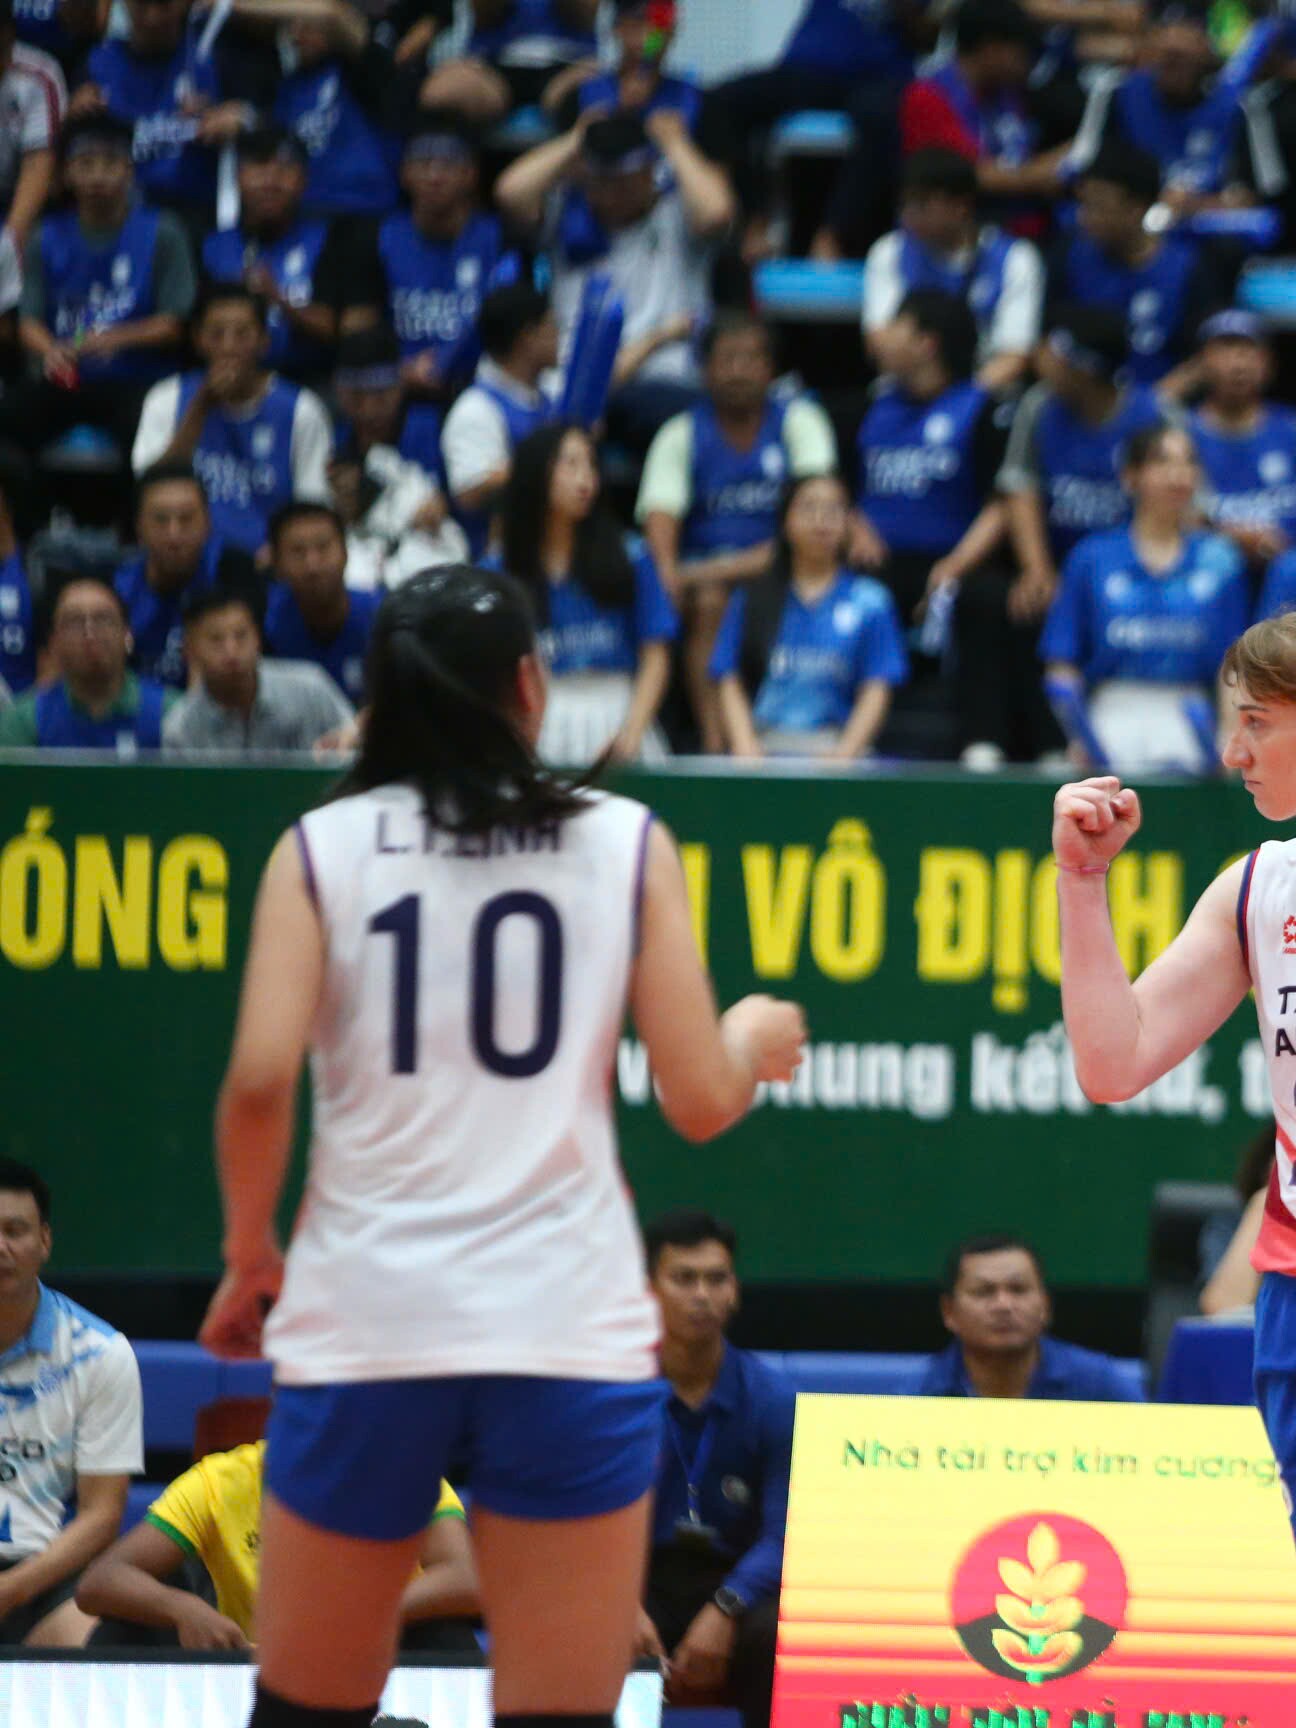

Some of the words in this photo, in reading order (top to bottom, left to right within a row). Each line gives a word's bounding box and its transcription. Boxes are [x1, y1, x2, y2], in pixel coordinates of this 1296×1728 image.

[742, 816, 886, 982] VÔ
[368, 889, 563, 1079] 10
[1072, 1446, 1138, 1474] kim
